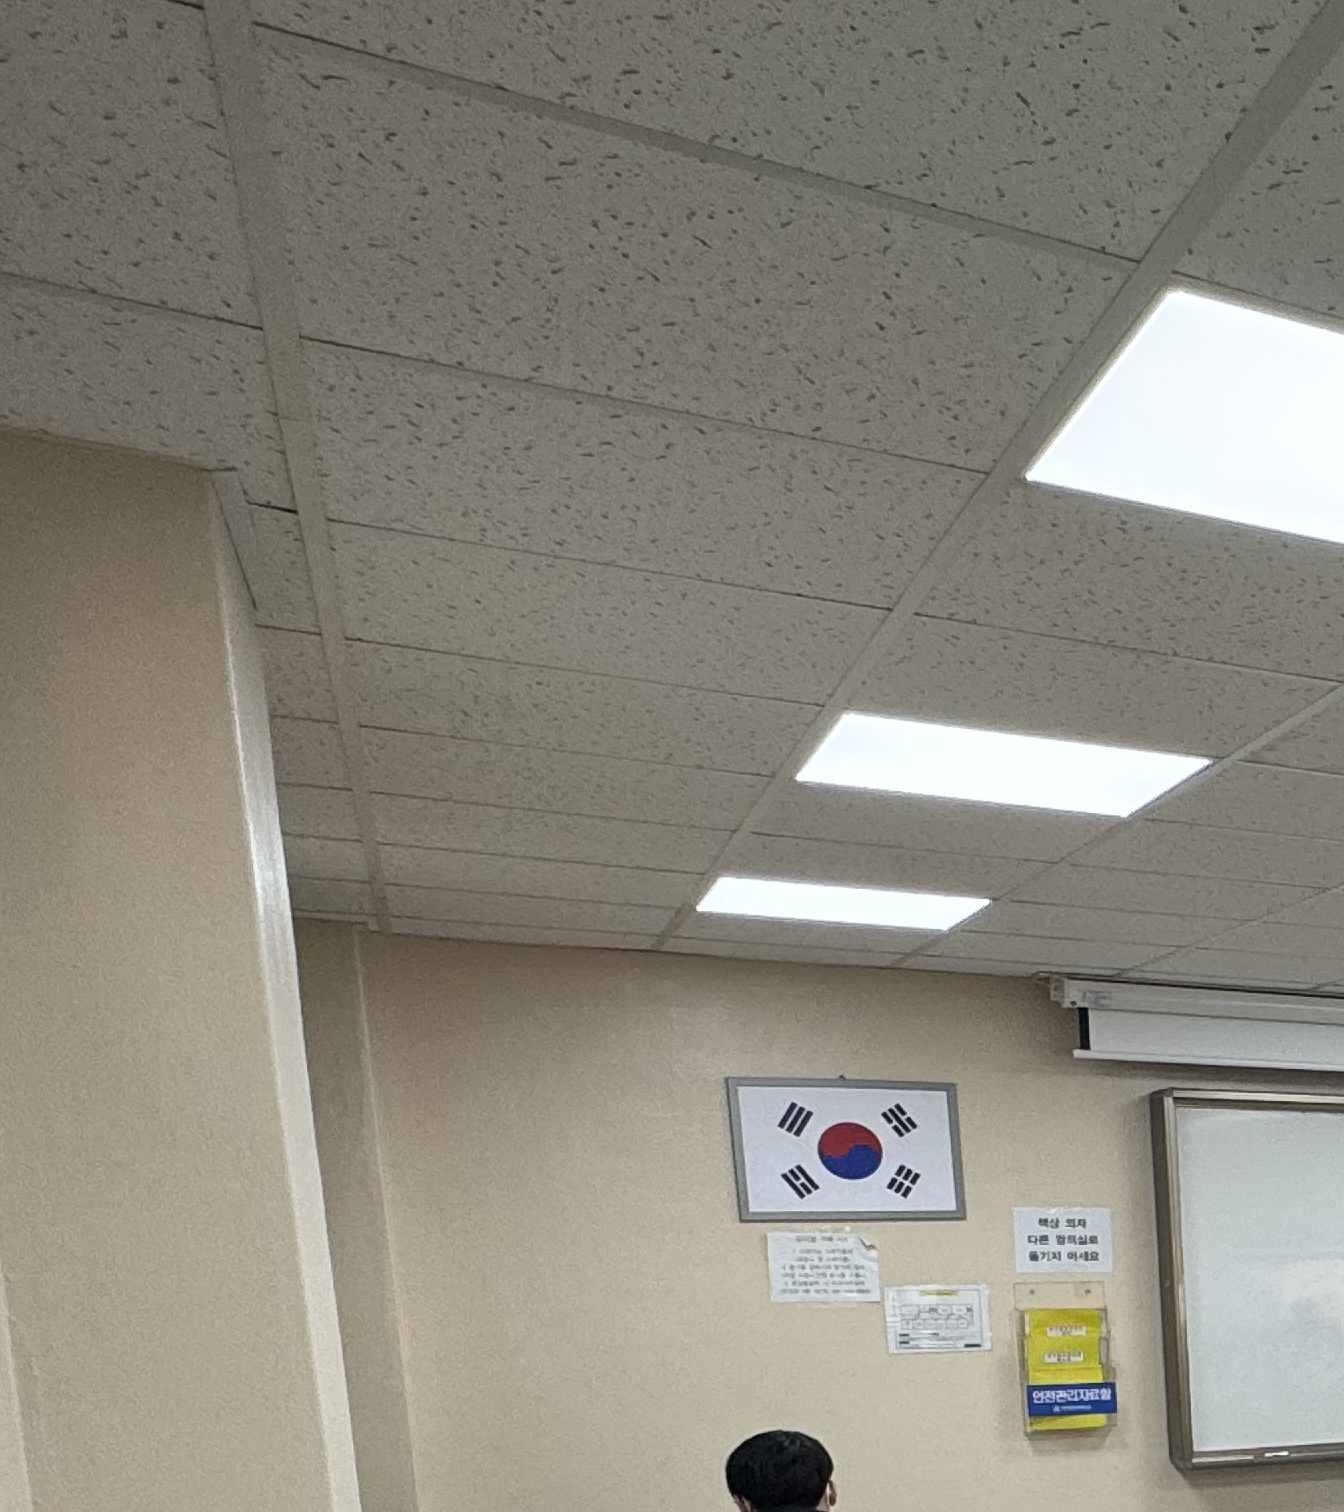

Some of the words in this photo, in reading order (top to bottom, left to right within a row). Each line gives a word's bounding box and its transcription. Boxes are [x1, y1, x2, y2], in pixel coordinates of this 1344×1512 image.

[1038, 1217, 1060, 1229] 책상
[1065, 1217, 1087, 1229] 의자
[1026, 1234, 1050, 1246] 다른
[1028, 1250, 1062, 1262] 옮기지
[1066, 1250, 1100, 1262] 마세요
